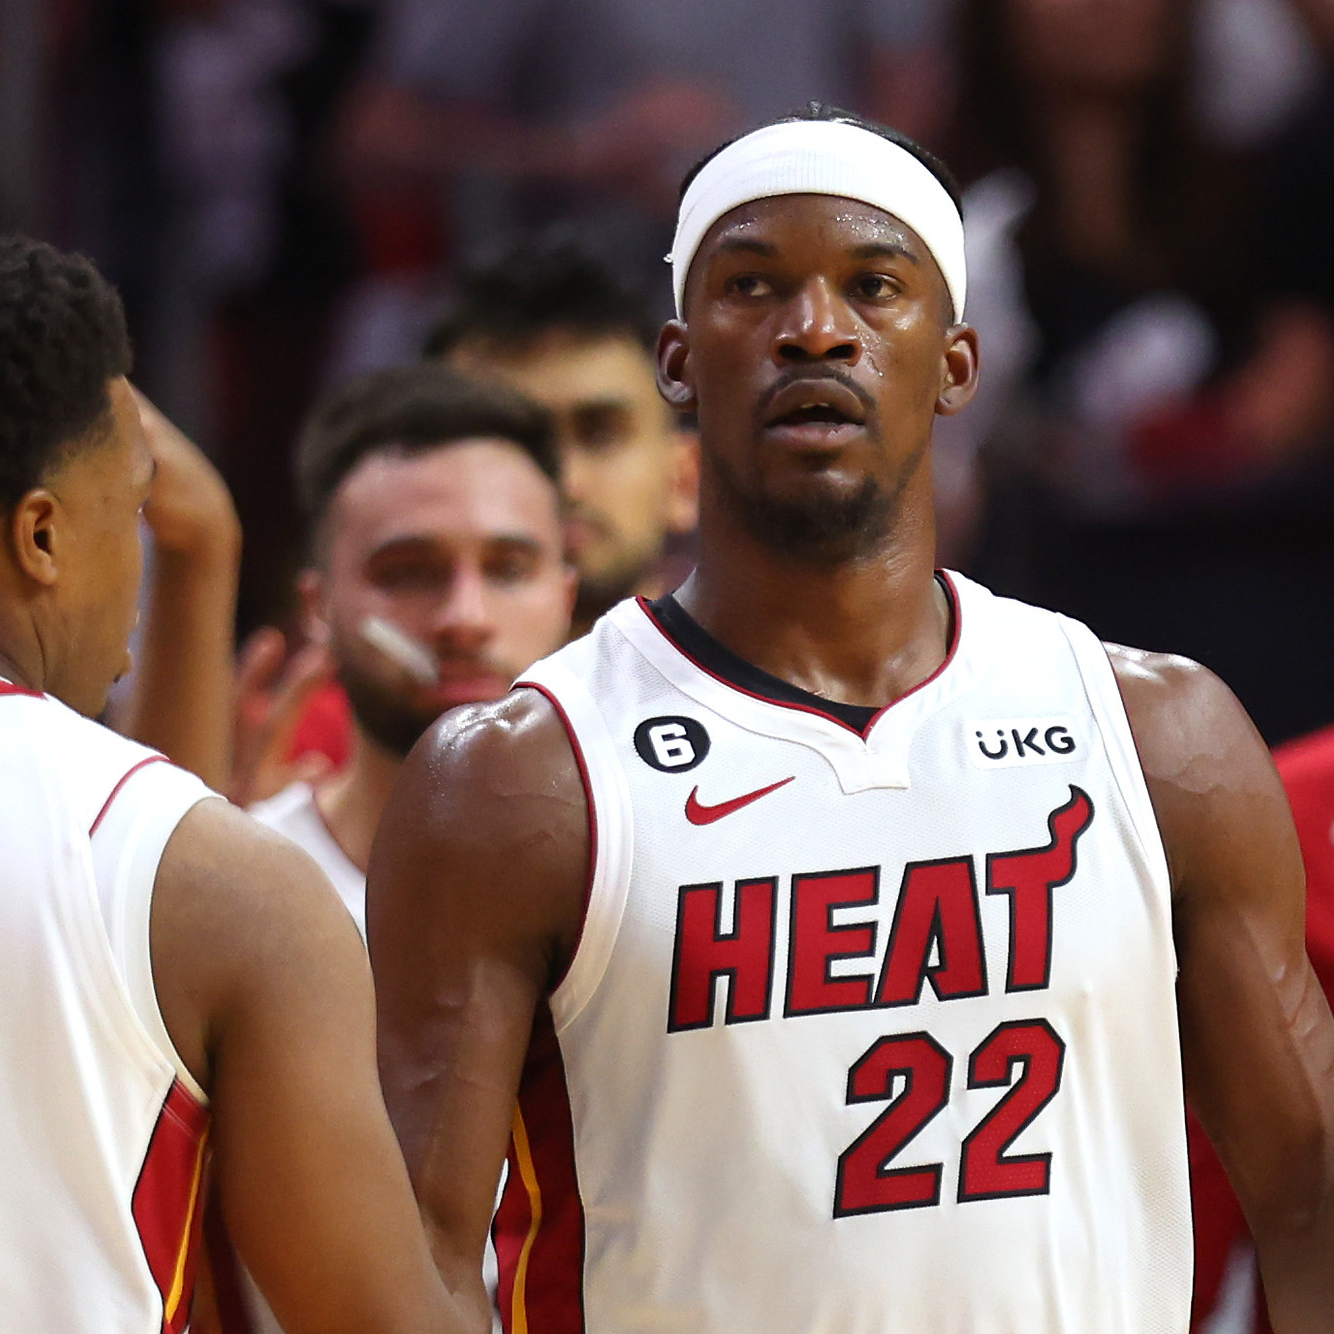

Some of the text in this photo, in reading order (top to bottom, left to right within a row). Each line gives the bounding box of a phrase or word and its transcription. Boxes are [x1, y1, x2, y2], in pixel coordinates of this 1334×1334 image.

[648, 722, 696, 768] 6
[668, 783, 1095, 1034] HEAT
[833, 1018, 1066, 1219] 22
